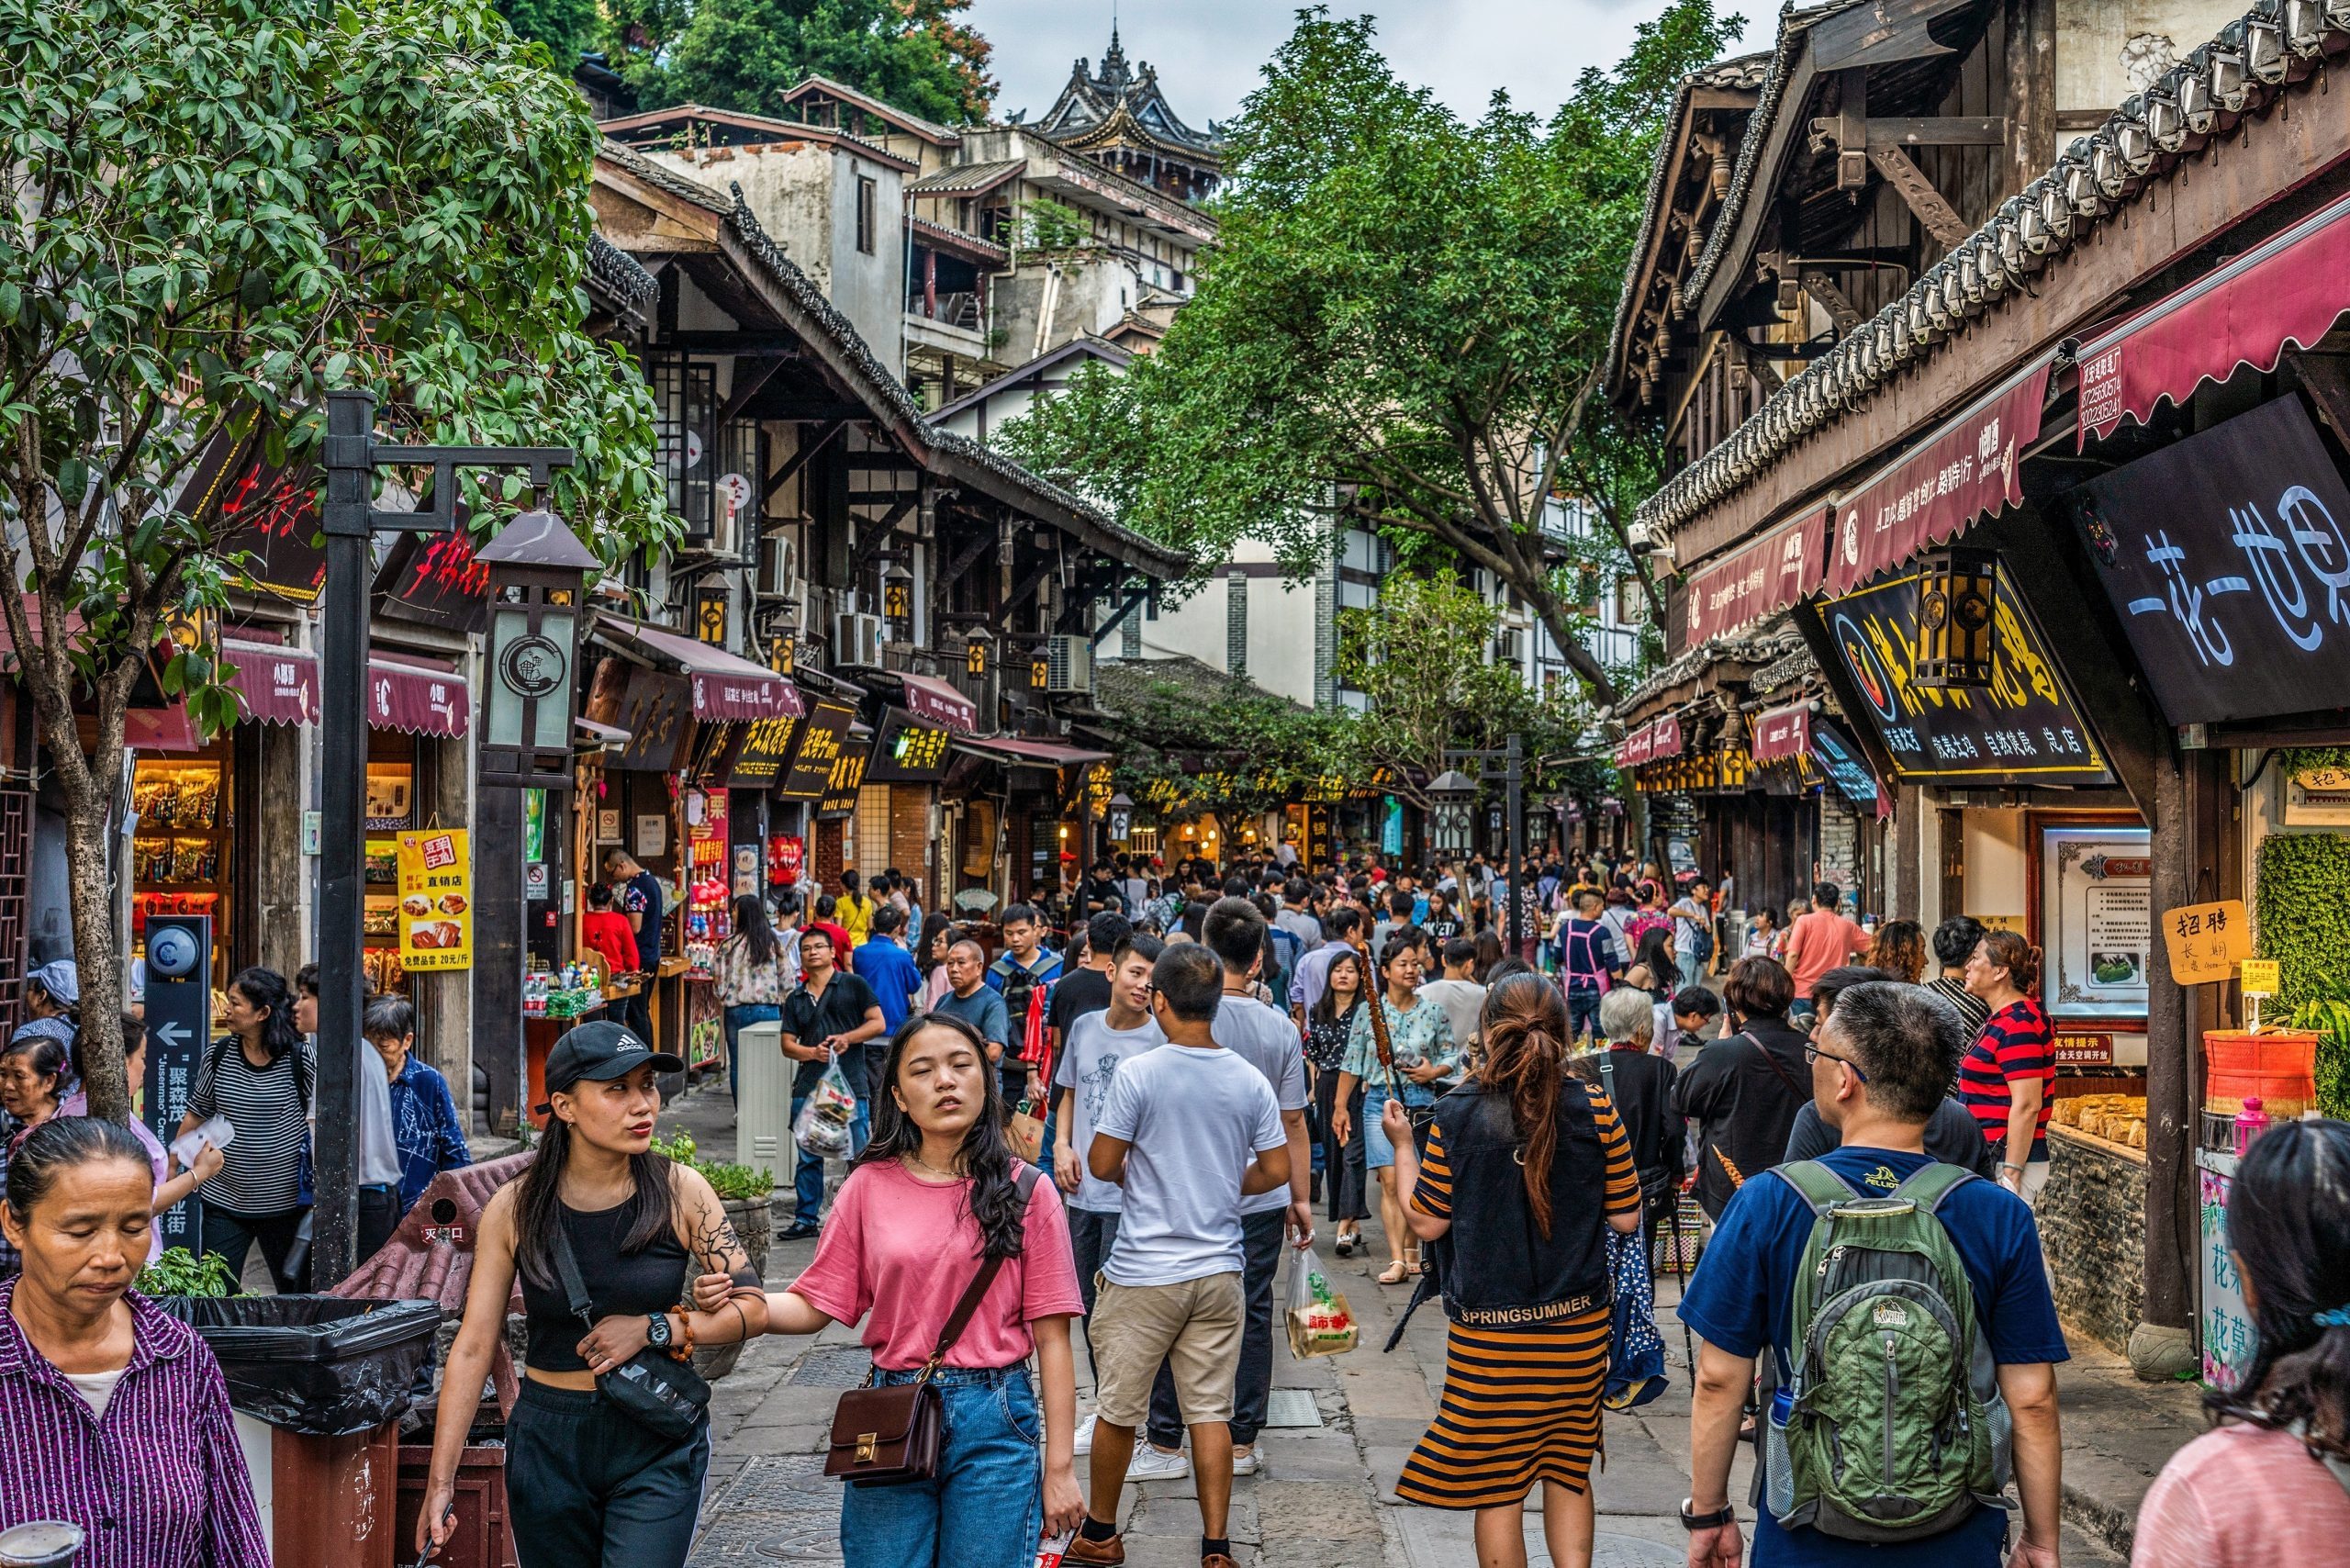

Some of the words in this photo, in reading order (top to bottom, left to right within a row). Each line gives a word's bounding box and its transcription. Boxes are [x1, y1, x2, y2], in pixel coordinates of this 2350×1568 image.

[2177, 908, 2228, 938] 招聘
[405, 955, 436, 966] 免费品尝
[440, 954, 468, 965] 20元/斤
[425, 1227, 463, 1240] 灭口
[1461, 1294, 1592, 1324] SPRINGSUMMER
